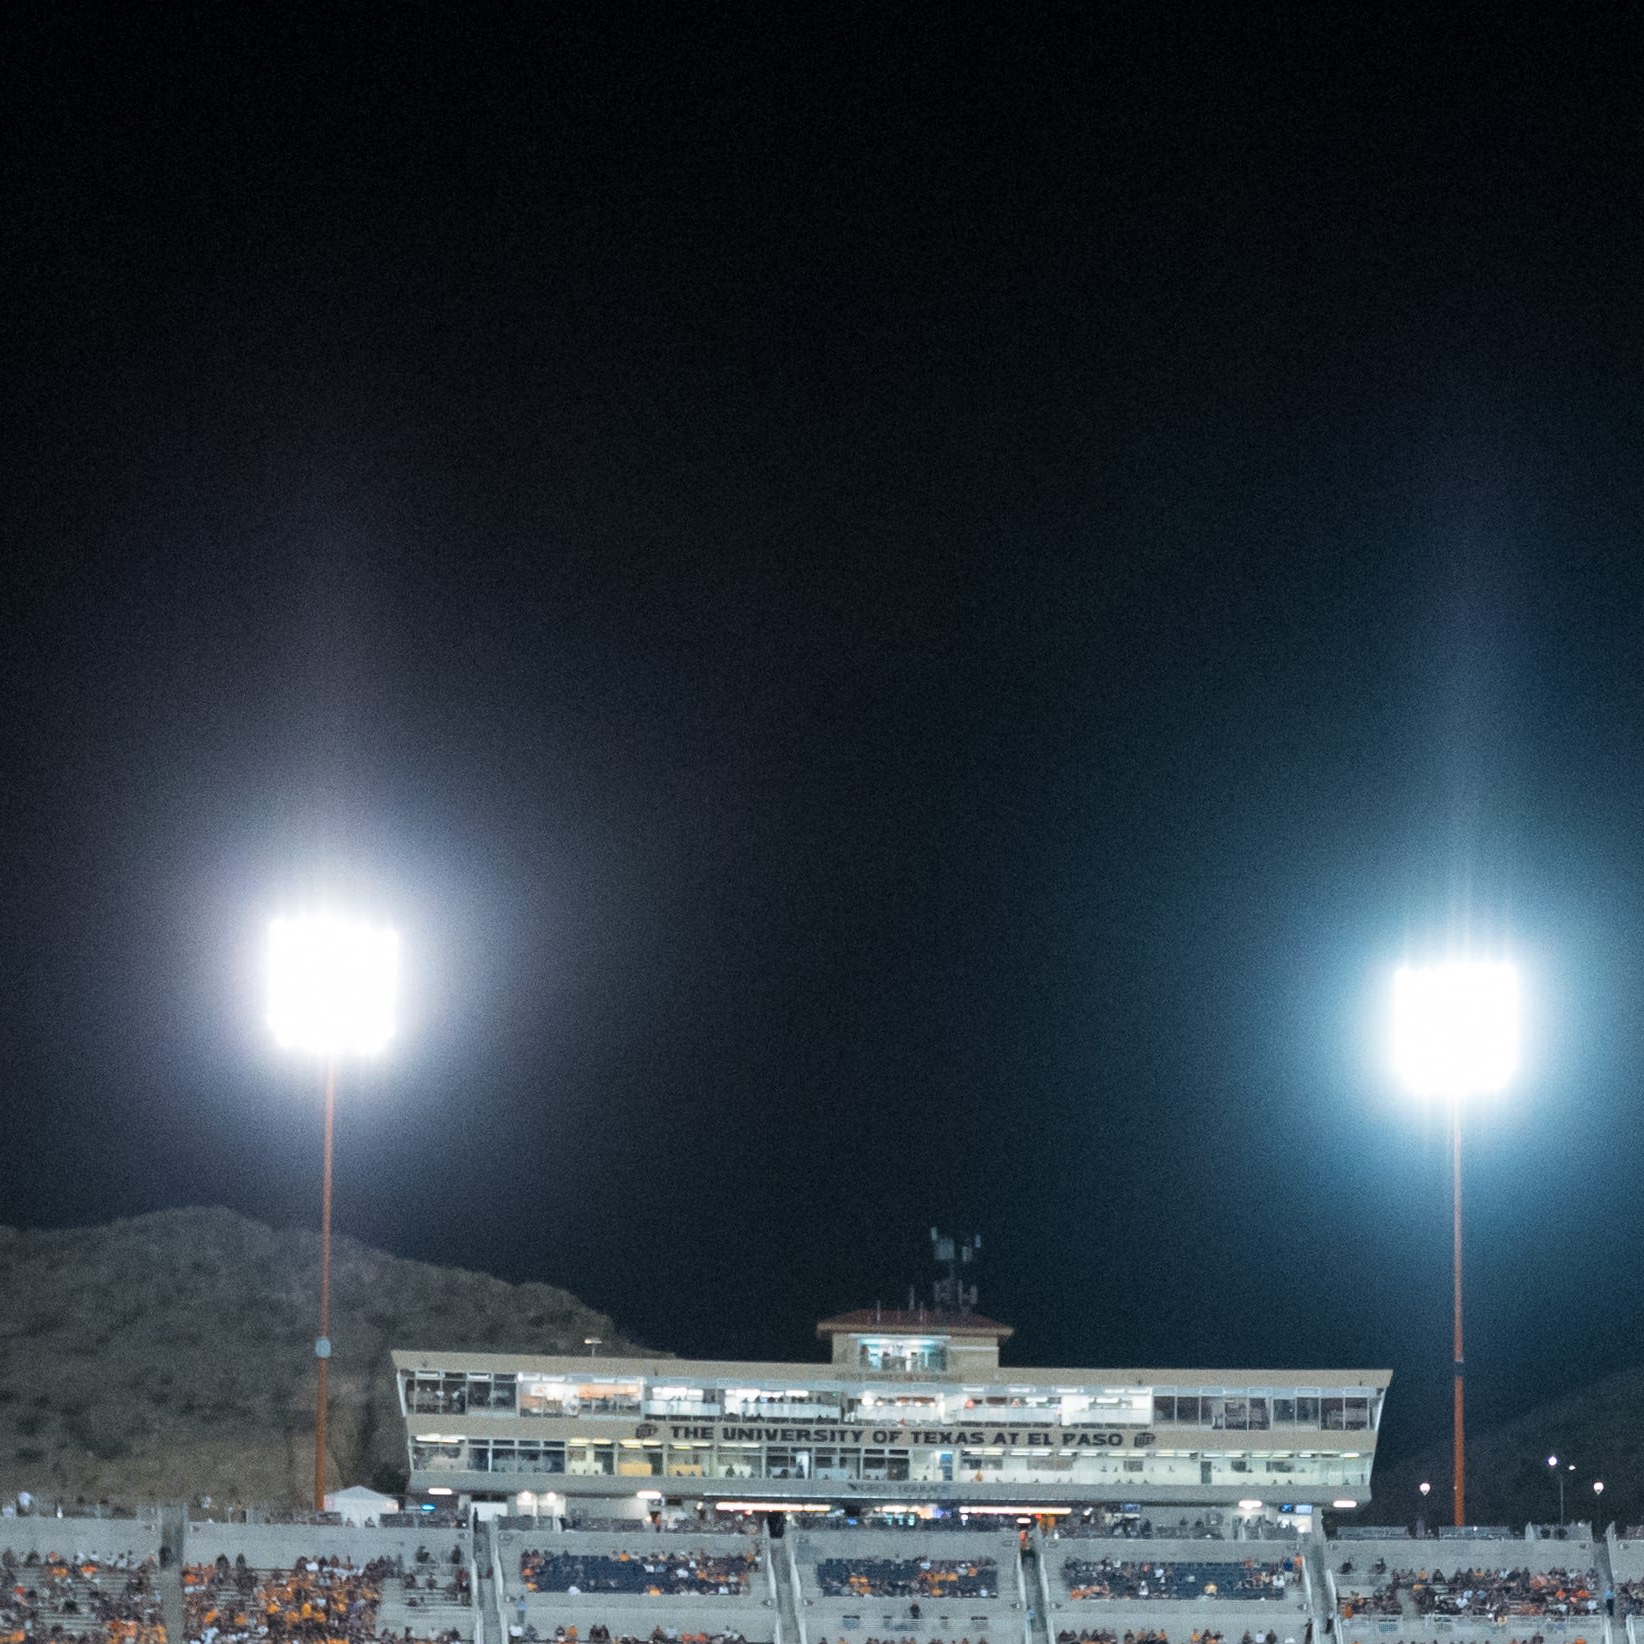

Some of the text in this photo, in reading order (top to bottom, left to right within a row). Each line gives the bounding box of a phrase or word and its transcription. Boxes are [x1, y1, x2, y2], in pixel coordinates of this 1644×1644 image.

[671, 1426, 714, 1440] THE
[723, 1426, 863, 1443] UNIVERSITY
[873, 1430, 903, 1444] OF
[911, 1431, 984, 1445] TEXAS
[994, 1431, 1019, 1445] AT
[1028, 1432, 1051, 1445] EL
[1062, 1432, 1124, 1447] PASO
